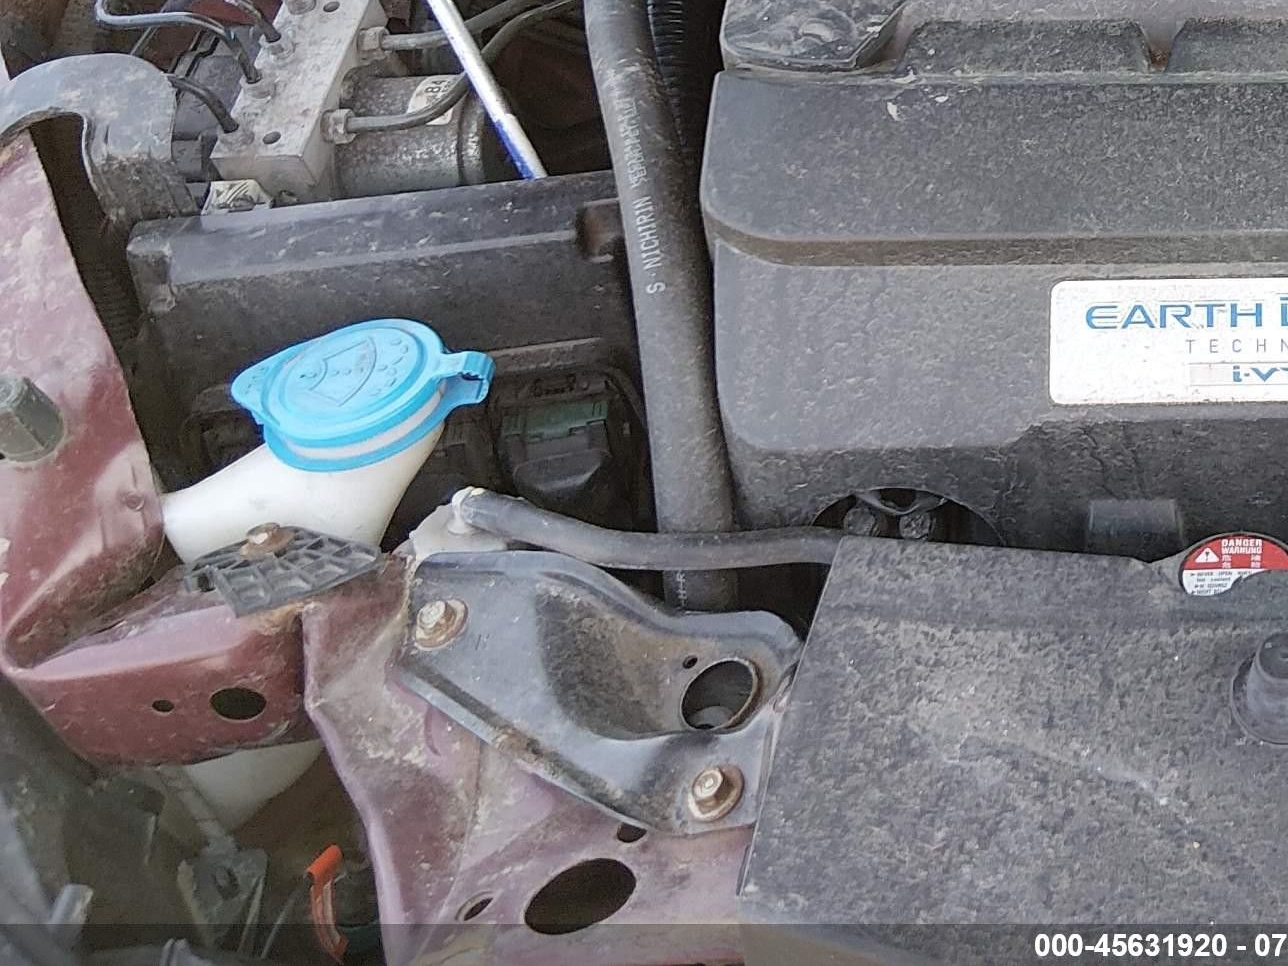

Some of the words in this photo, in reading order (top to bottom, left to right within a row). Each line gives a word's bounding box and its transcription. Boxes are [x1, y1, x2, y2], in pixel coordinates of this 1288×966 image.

[633, 195, 663, 270] NICHIRIN
[1085, 302, 1264, 330] EARTH
[1221, 538, 1263, 547] DANGER
